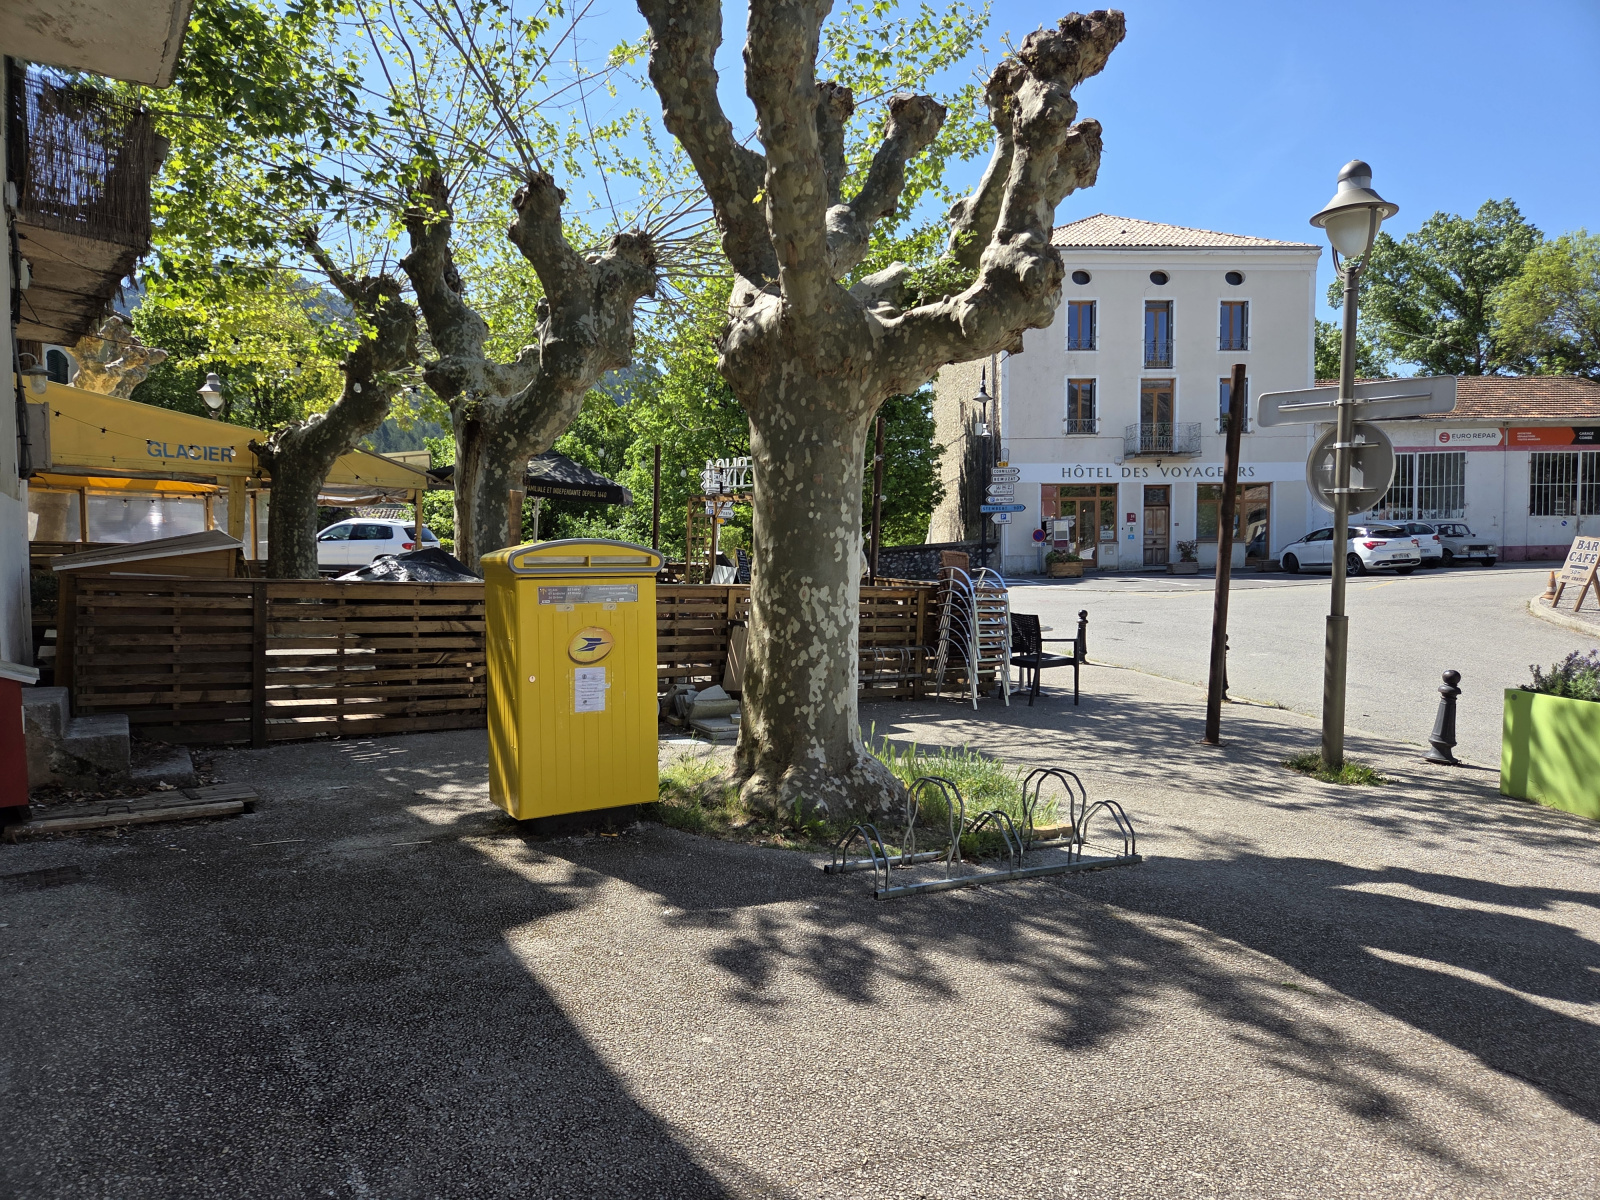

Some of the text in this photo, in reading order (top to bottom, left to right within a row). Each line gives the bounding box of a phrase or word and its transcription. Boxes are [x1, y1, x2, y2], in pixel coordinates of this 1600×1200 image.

[147, 440, 232, 462] GLACIER
[1062, 464, 1255, 478] HÔTEL DES VOYAGERS
[1576, 540, 1599, 551] BAR
